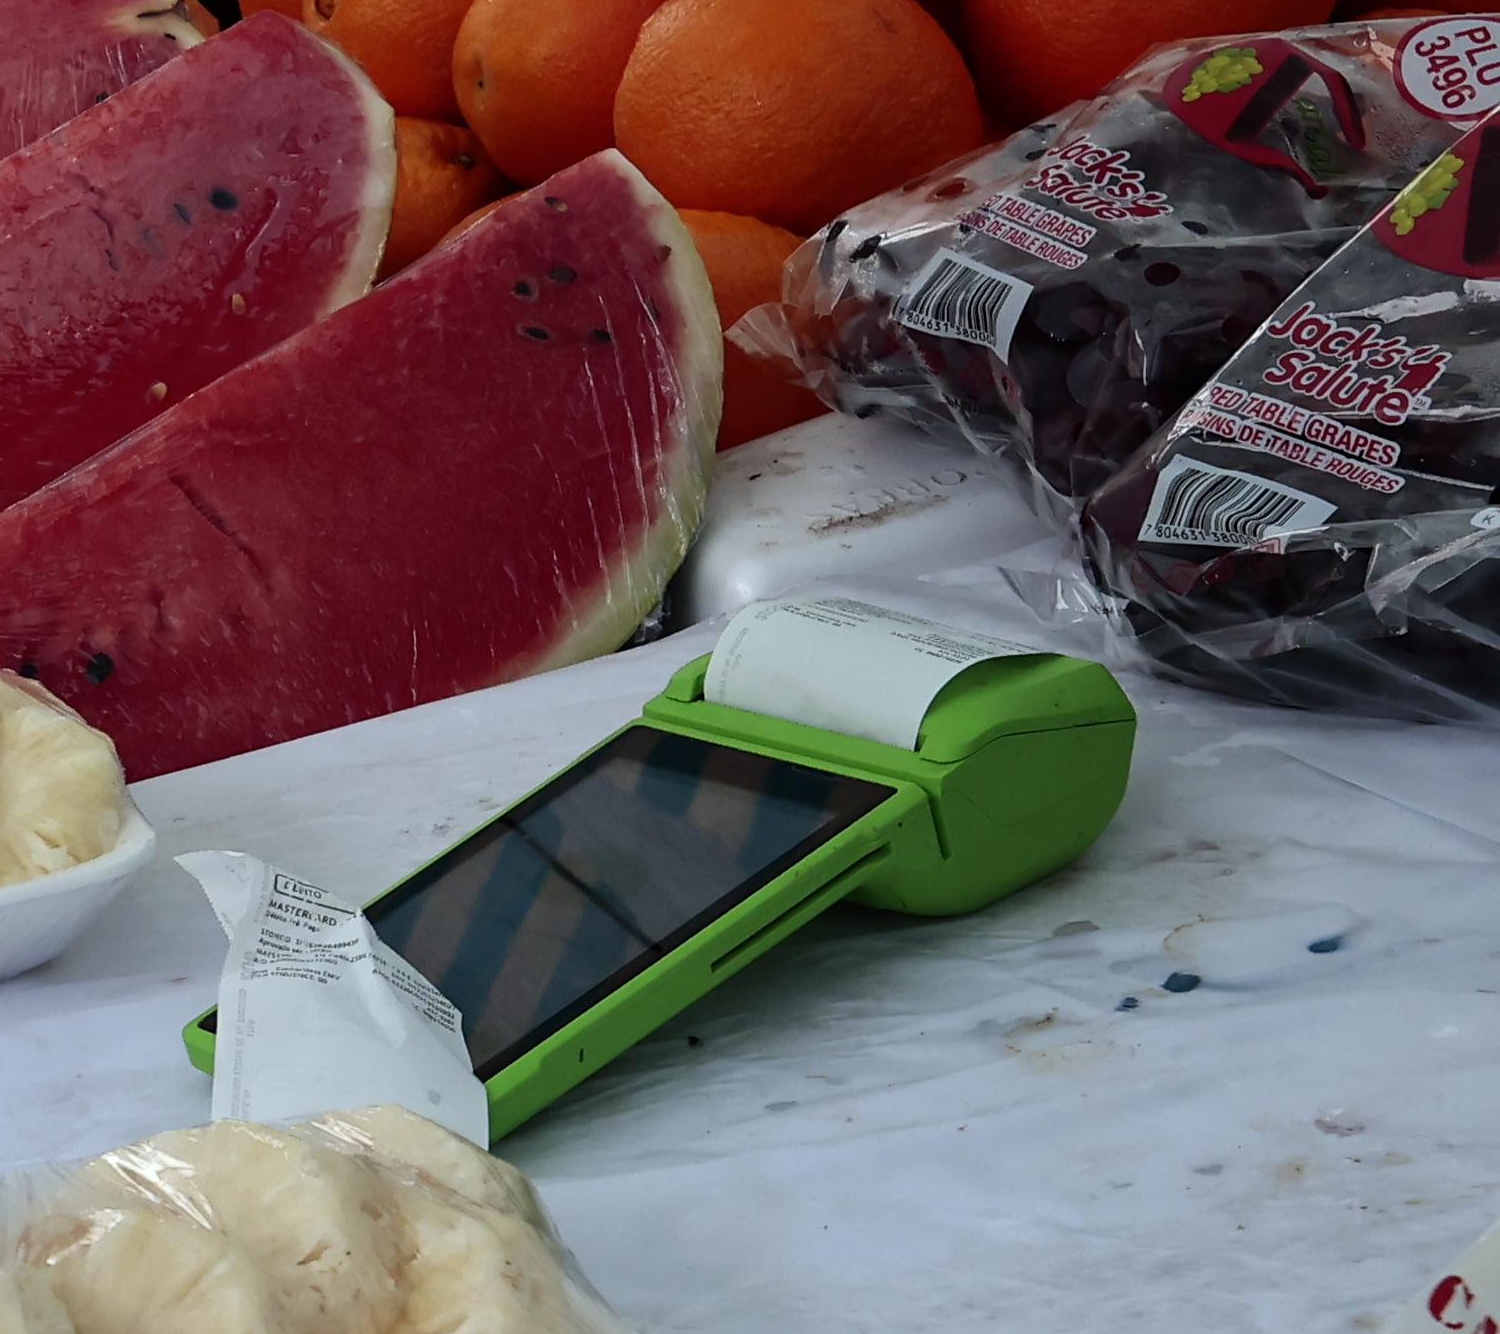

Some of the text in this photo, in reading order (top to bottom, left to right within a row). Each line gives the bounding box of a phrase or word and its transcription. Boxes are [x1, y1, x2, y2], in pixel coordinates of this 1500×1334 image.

[1415, 34, 1477, 110] 3496
[1455, 26, 1500, 87] PLU
[1024, 163, 1129, 220] Salute
[1046, 134, 1143, 199] Jack's
[985, 219, 1004, 236] DE
[1000, 225, 1039, 252] TABLE
[1035, 238, 1086, 269] ROUGES
[997, 196, 1039, 226] TABLE
[1033, 208, 1094, 248] GRAPES
[1267, 303, 1404, 368] Jack's
[1265, 351, 1411, 423] Salute
[1209, 386, 1398, 467] RED TABLE GRAPES
[1237, 426, 1269, 447] DE
[1267, 434, 1328, 469] TABLE
[1325, 459, 1401, 493] ROUGES
